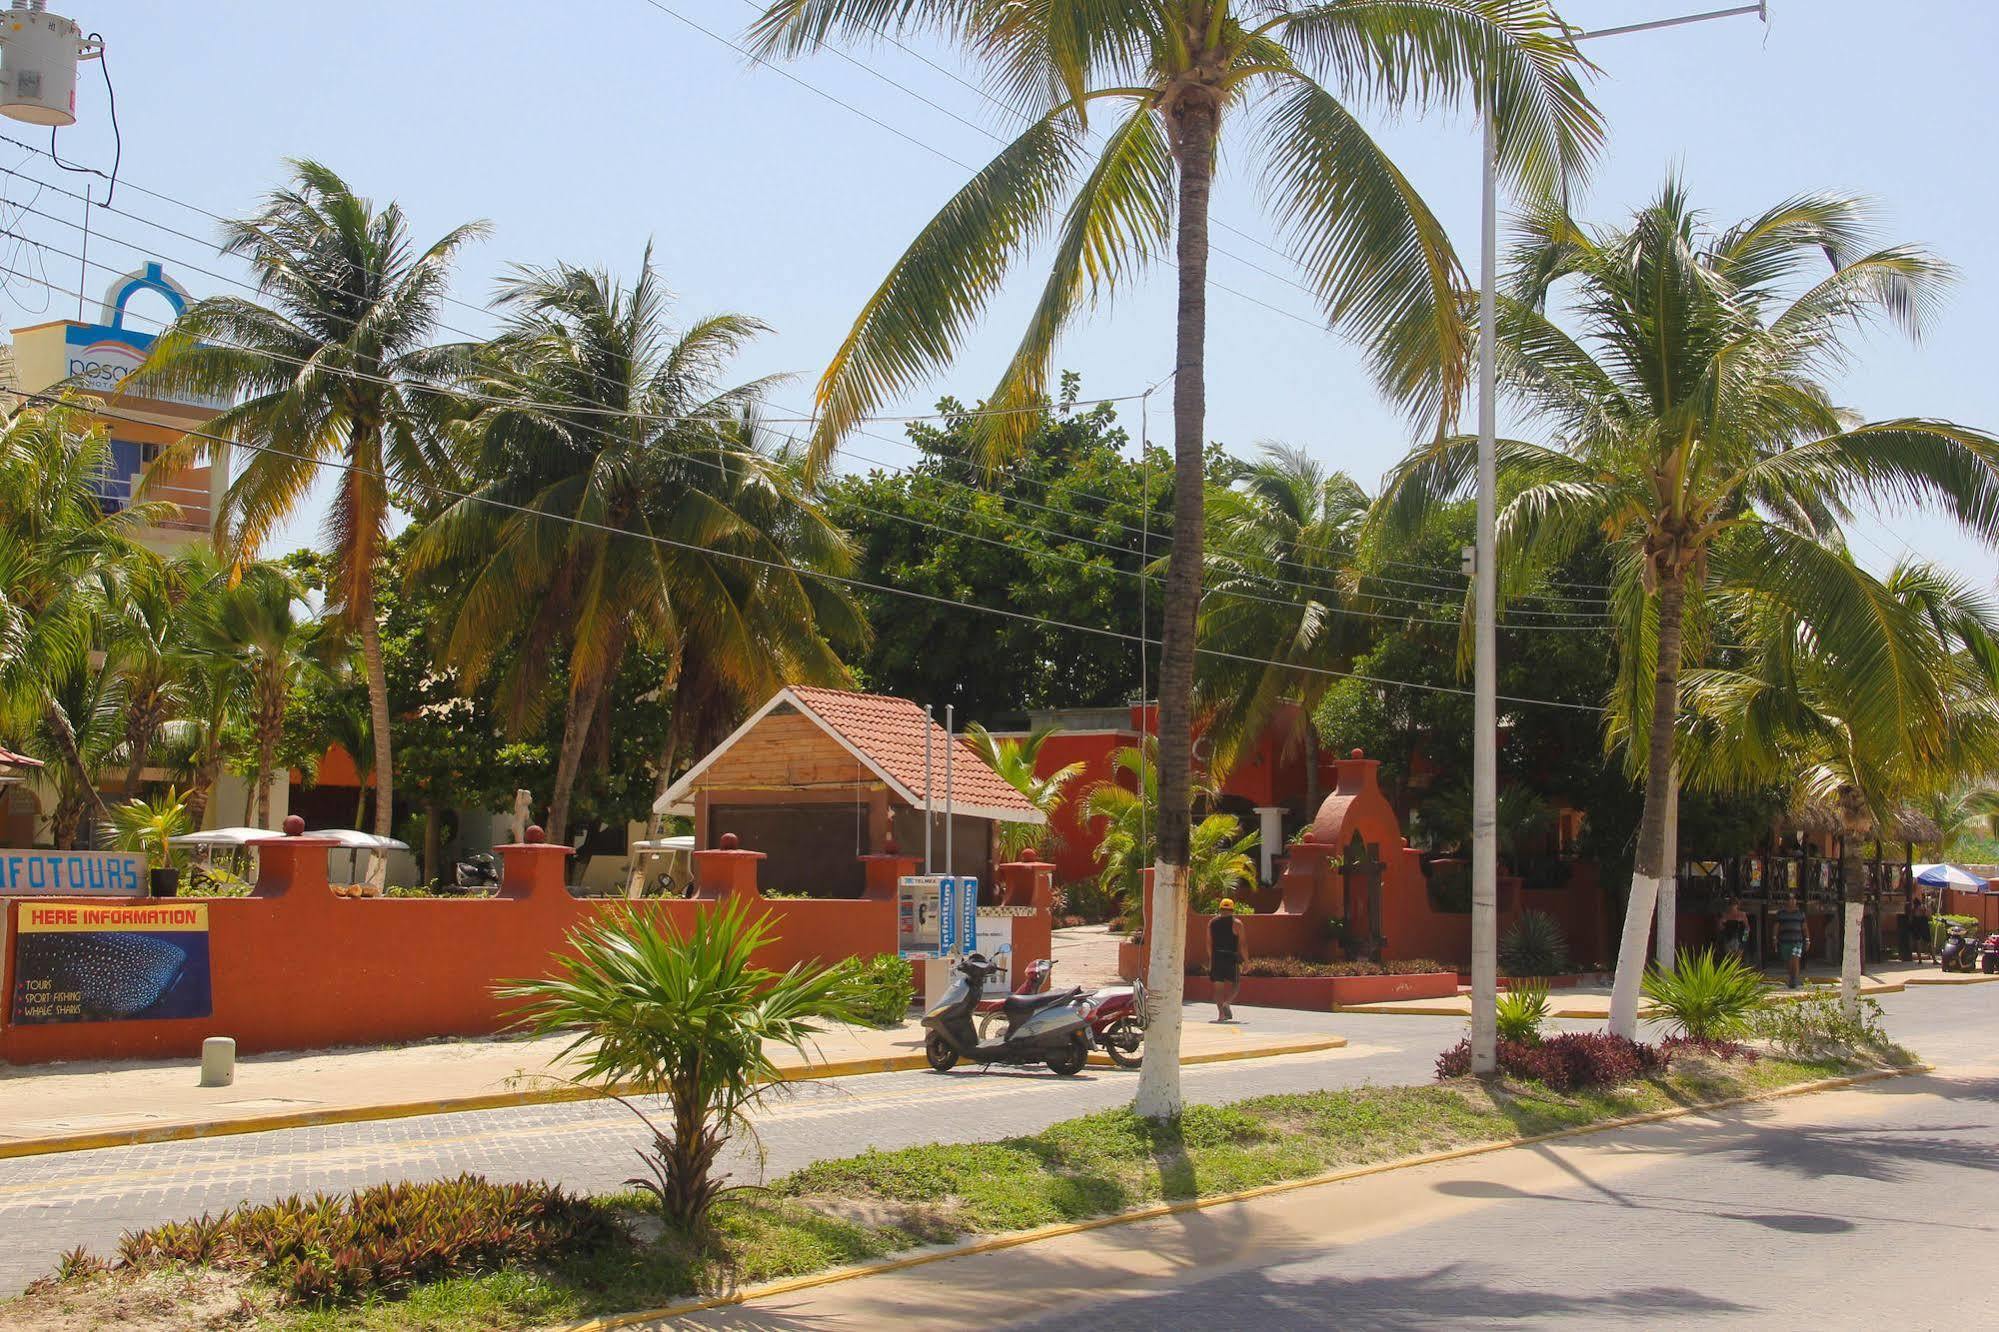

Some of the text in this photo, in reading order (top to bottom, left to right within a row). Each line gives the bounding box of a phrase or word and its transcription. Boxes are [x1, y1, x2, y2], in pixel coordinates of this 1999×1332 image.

[70, 359, 136, 383] posa
[32, 909, 197, 925] HERE INFORMATION
[942, 884, 951, 948] infinitum
[964, 884, 972, 947] infinitum
[25, 979, 53, 991] TOURS
[25, 991, 81, 1004] SPORT FISHING
[24, 1004, 53, 1016] WHALE
